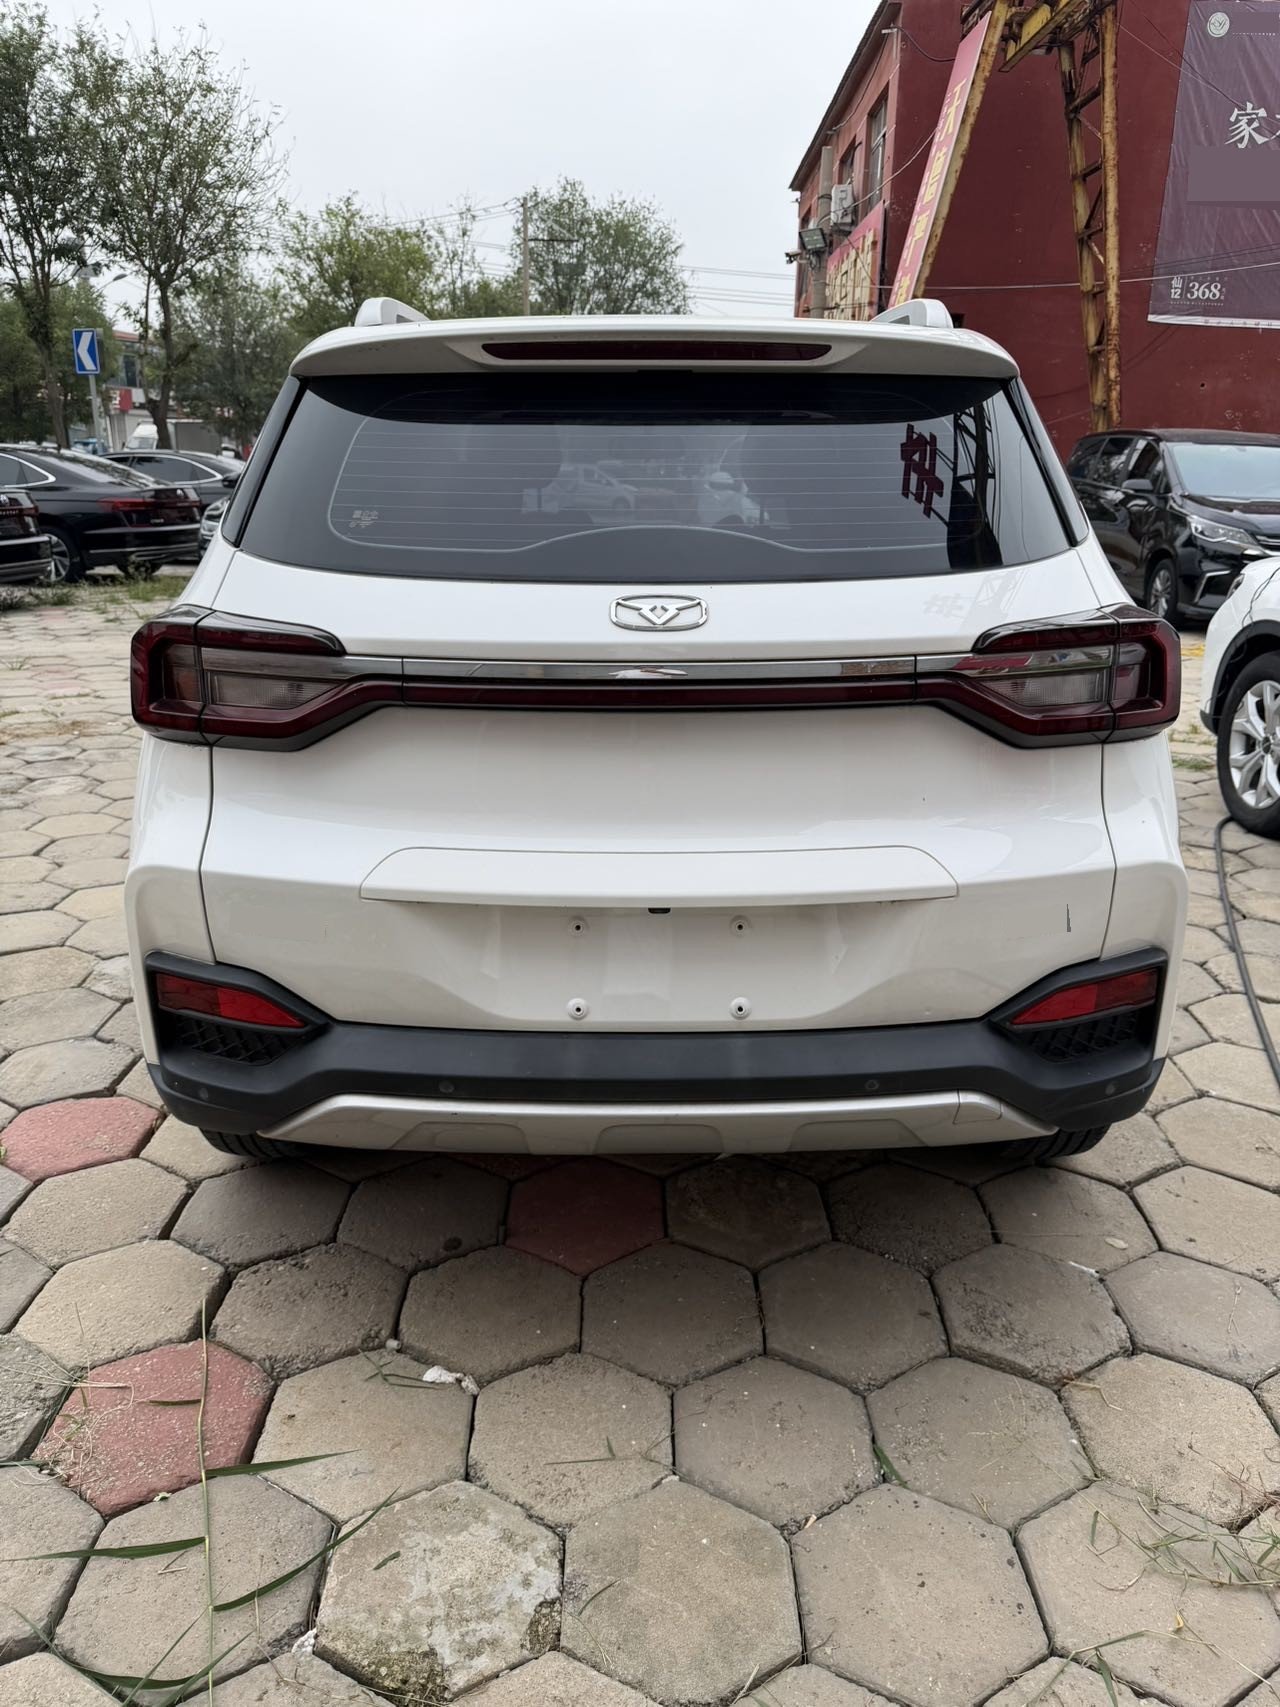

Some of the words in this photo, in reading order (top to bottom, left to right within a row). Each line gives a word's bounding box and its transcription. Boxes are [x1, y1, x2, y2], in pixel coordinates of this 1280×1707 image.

[1225, 101, 1280, 149] 家
[1170, 288, 1182, 299] 12
[1186, 281, 1221, 300] 368
